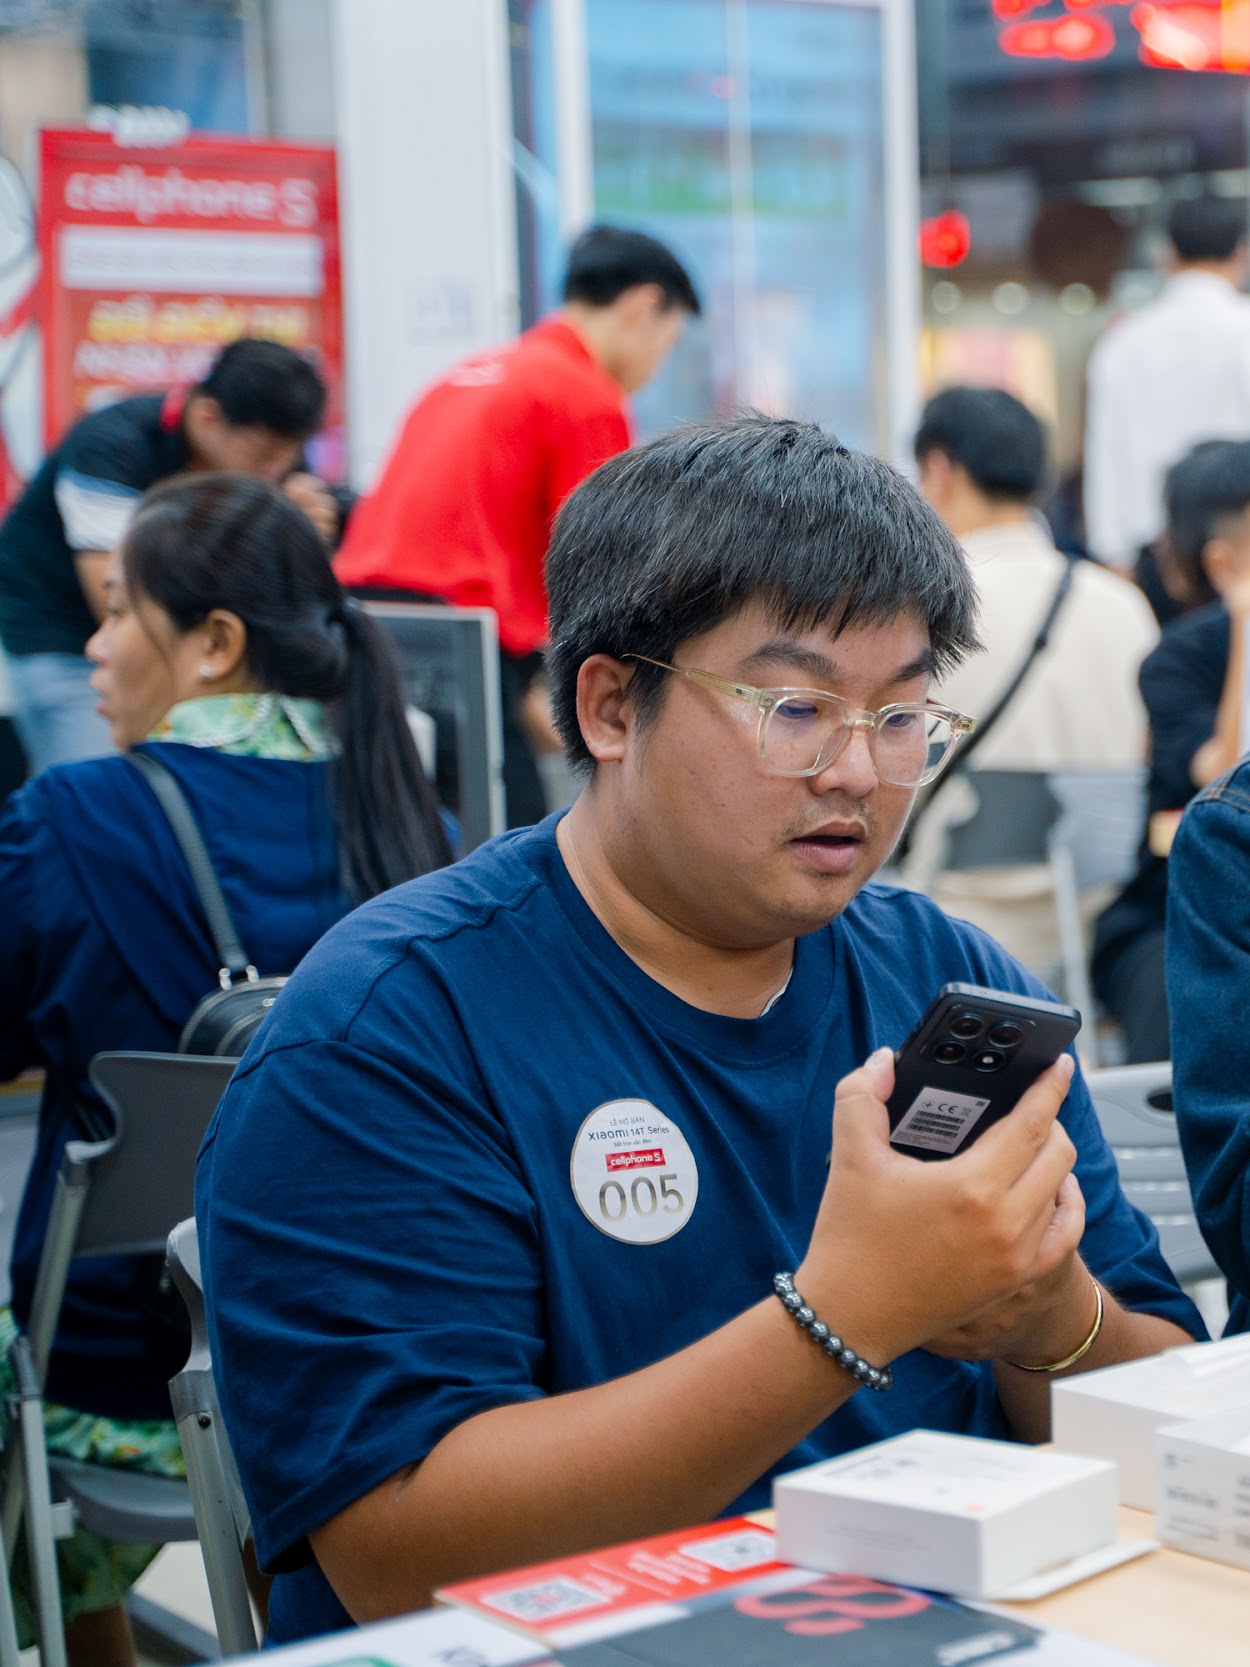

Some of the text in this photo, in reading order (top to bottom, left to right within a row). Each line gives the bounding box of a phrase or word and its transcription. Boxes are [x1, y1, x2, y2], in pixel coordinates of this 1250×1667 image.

[631, 1127, 645, 1136] 14T
[647, 1126, 670, 1134] Series
[611, 1154, 653, 1166] cellphone
[599, 1173, 684, 1223] 005
